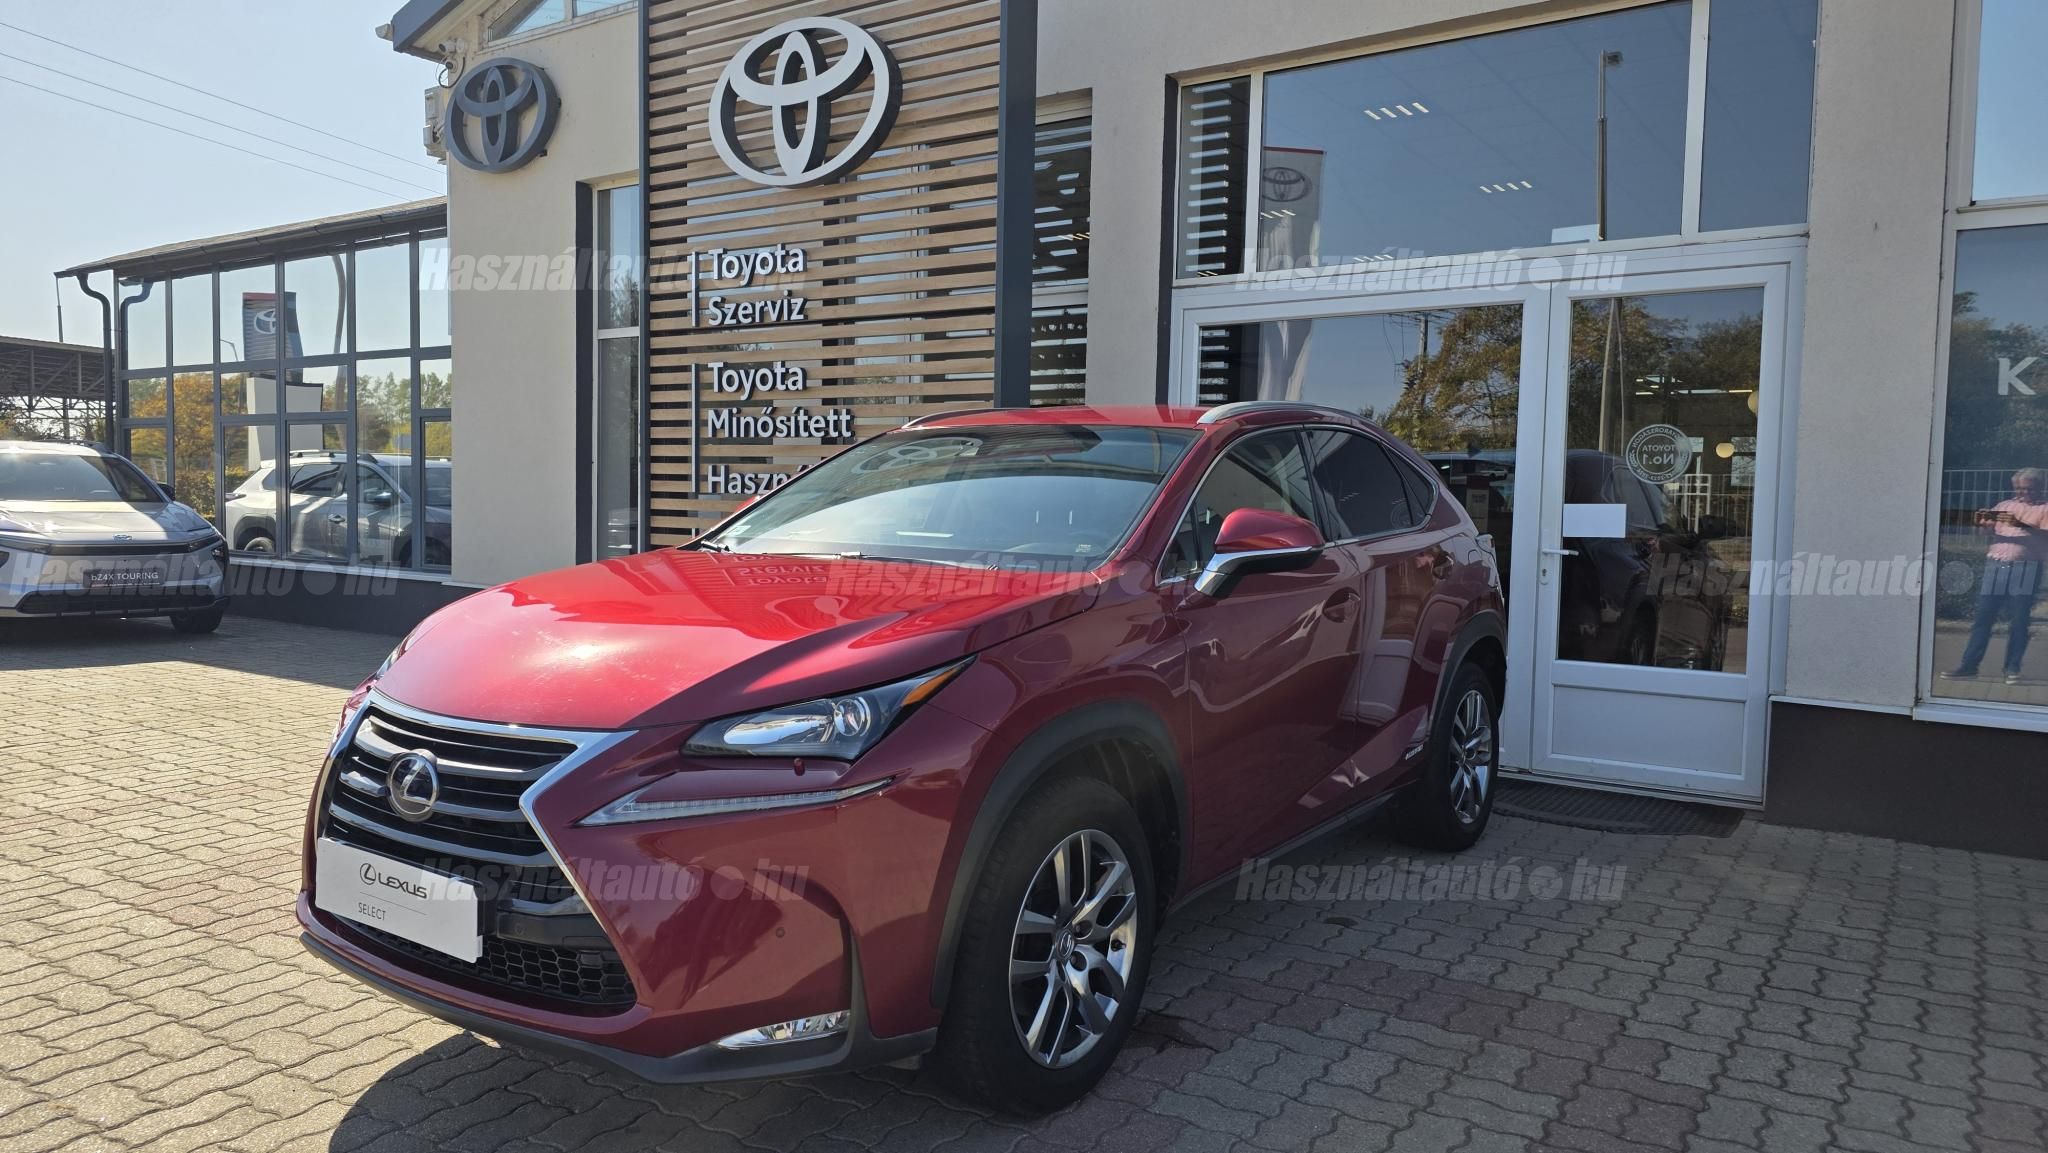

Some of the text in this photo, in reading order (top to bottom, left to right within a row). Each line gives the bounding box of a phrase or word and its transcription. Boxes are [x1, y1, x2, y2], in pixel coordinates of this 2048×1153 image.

[708, 243, 805, 287] Toyota
[708, 289, 805, 326] Szerviz
[708, 361, 804, 400] Toyota
[708, 406, 852, 438] Minősített
[707, 464, 803, 494] Haszn
[91, 571, 160, 581] bZ4X TOURING
[378, 872, 428, 899] LEXUS
[357, 902, 387, 921] SELECT
